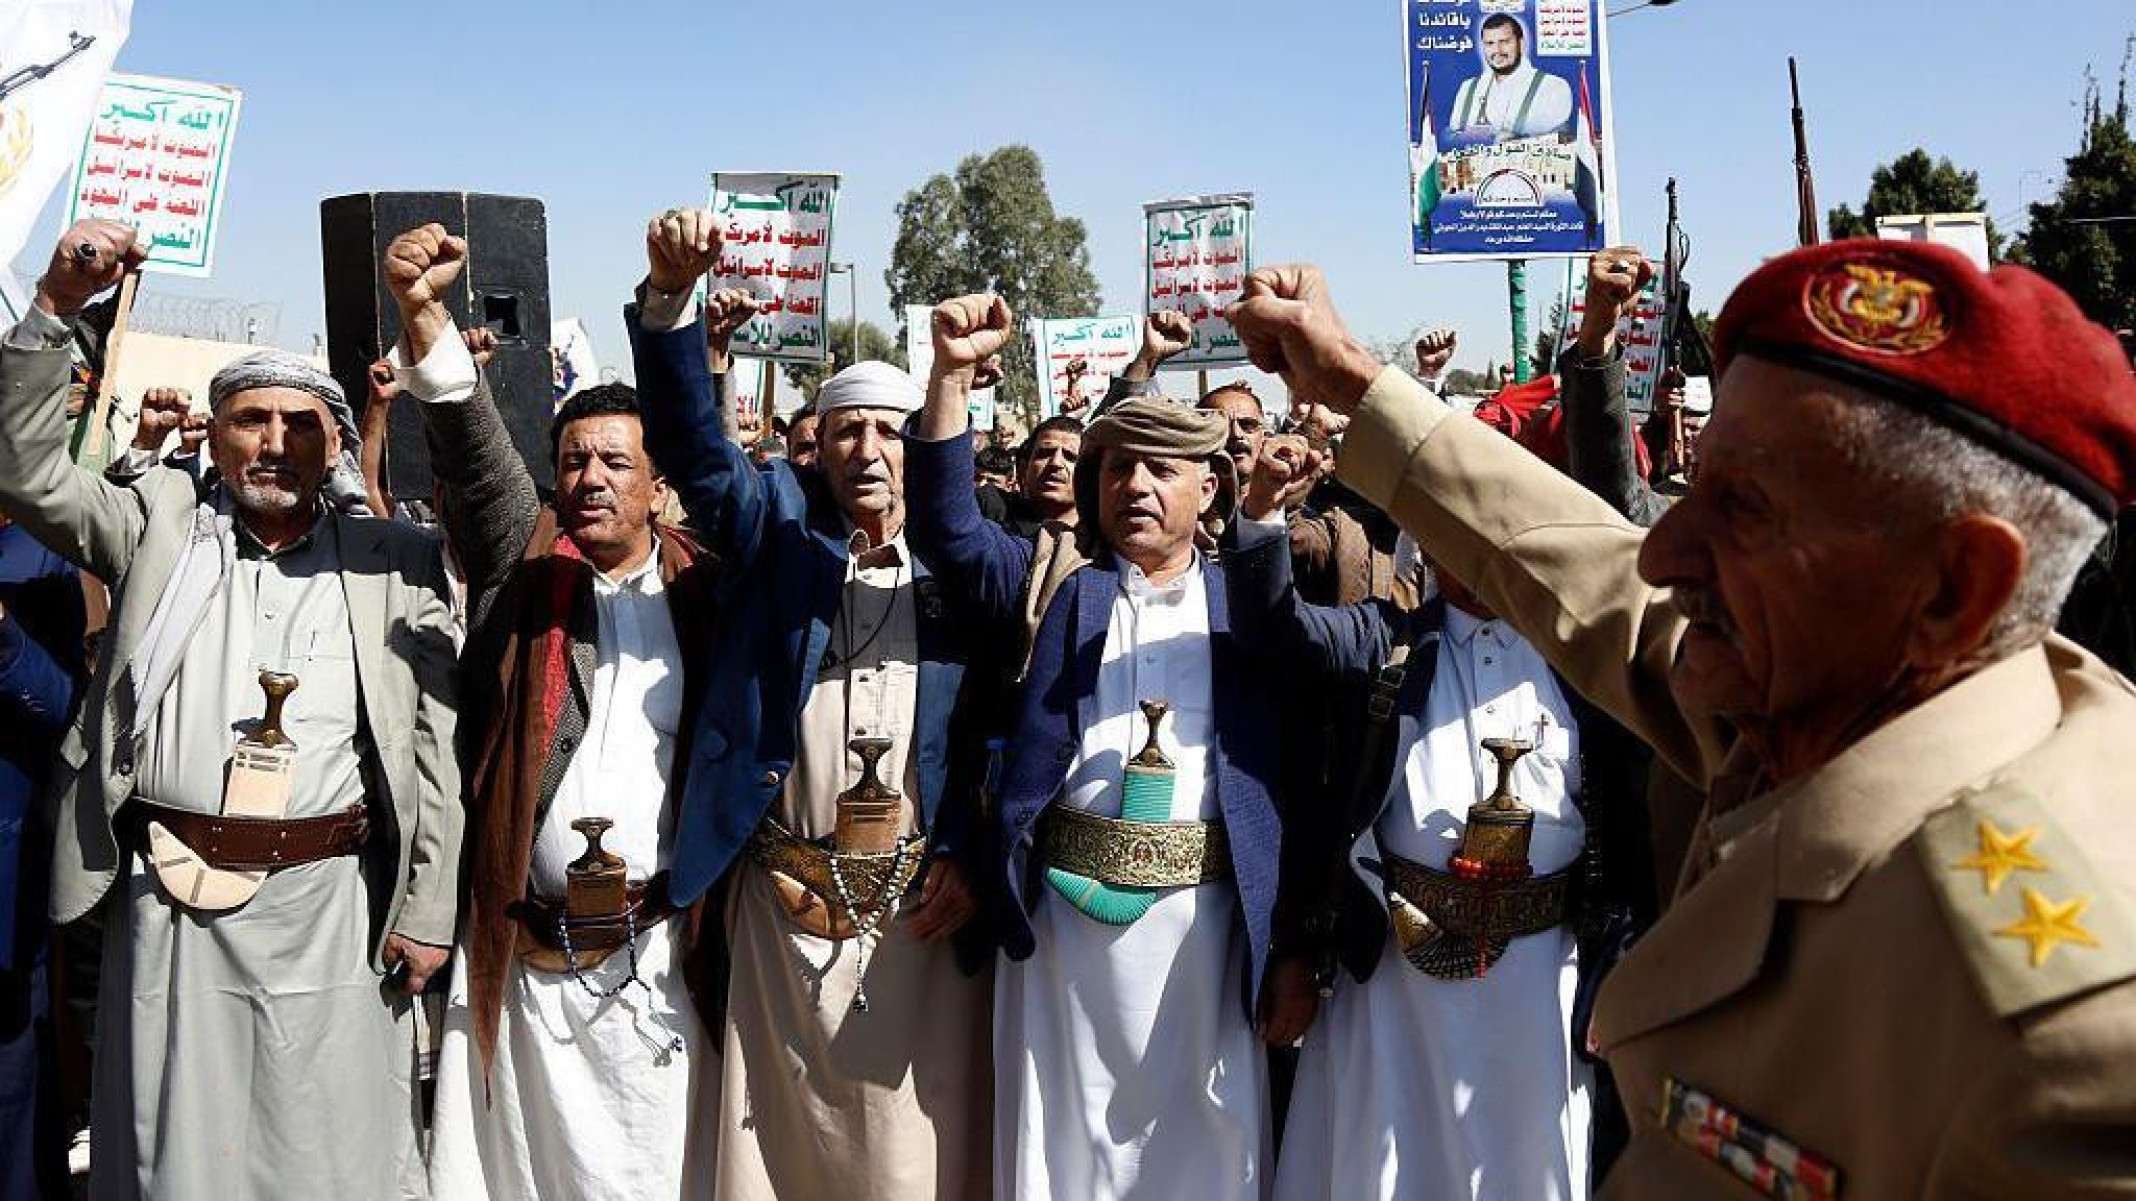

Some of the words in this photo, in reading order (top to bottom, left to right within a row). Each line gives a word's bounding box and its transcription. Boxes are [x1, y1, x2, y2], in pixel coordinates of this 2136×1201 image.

[178, 106, 223, 130] الله
[164, 140, 215, 159] الموت
[159, 169, 211, 188] الموت
[800, 180, 829, 214] الله
[1209, 213, 1244, 237] الله
[778, 228, 825, 248] الموت
[1203, 246, 1243, 268] الموت
[776, 261, 822, 282] الموت
[1203, 272, 1243, 295] الموت
[759, 294, 784, 316] على
[787, 293, 818, 316] اللعنة
[771, 323, 820, 350] النصر
